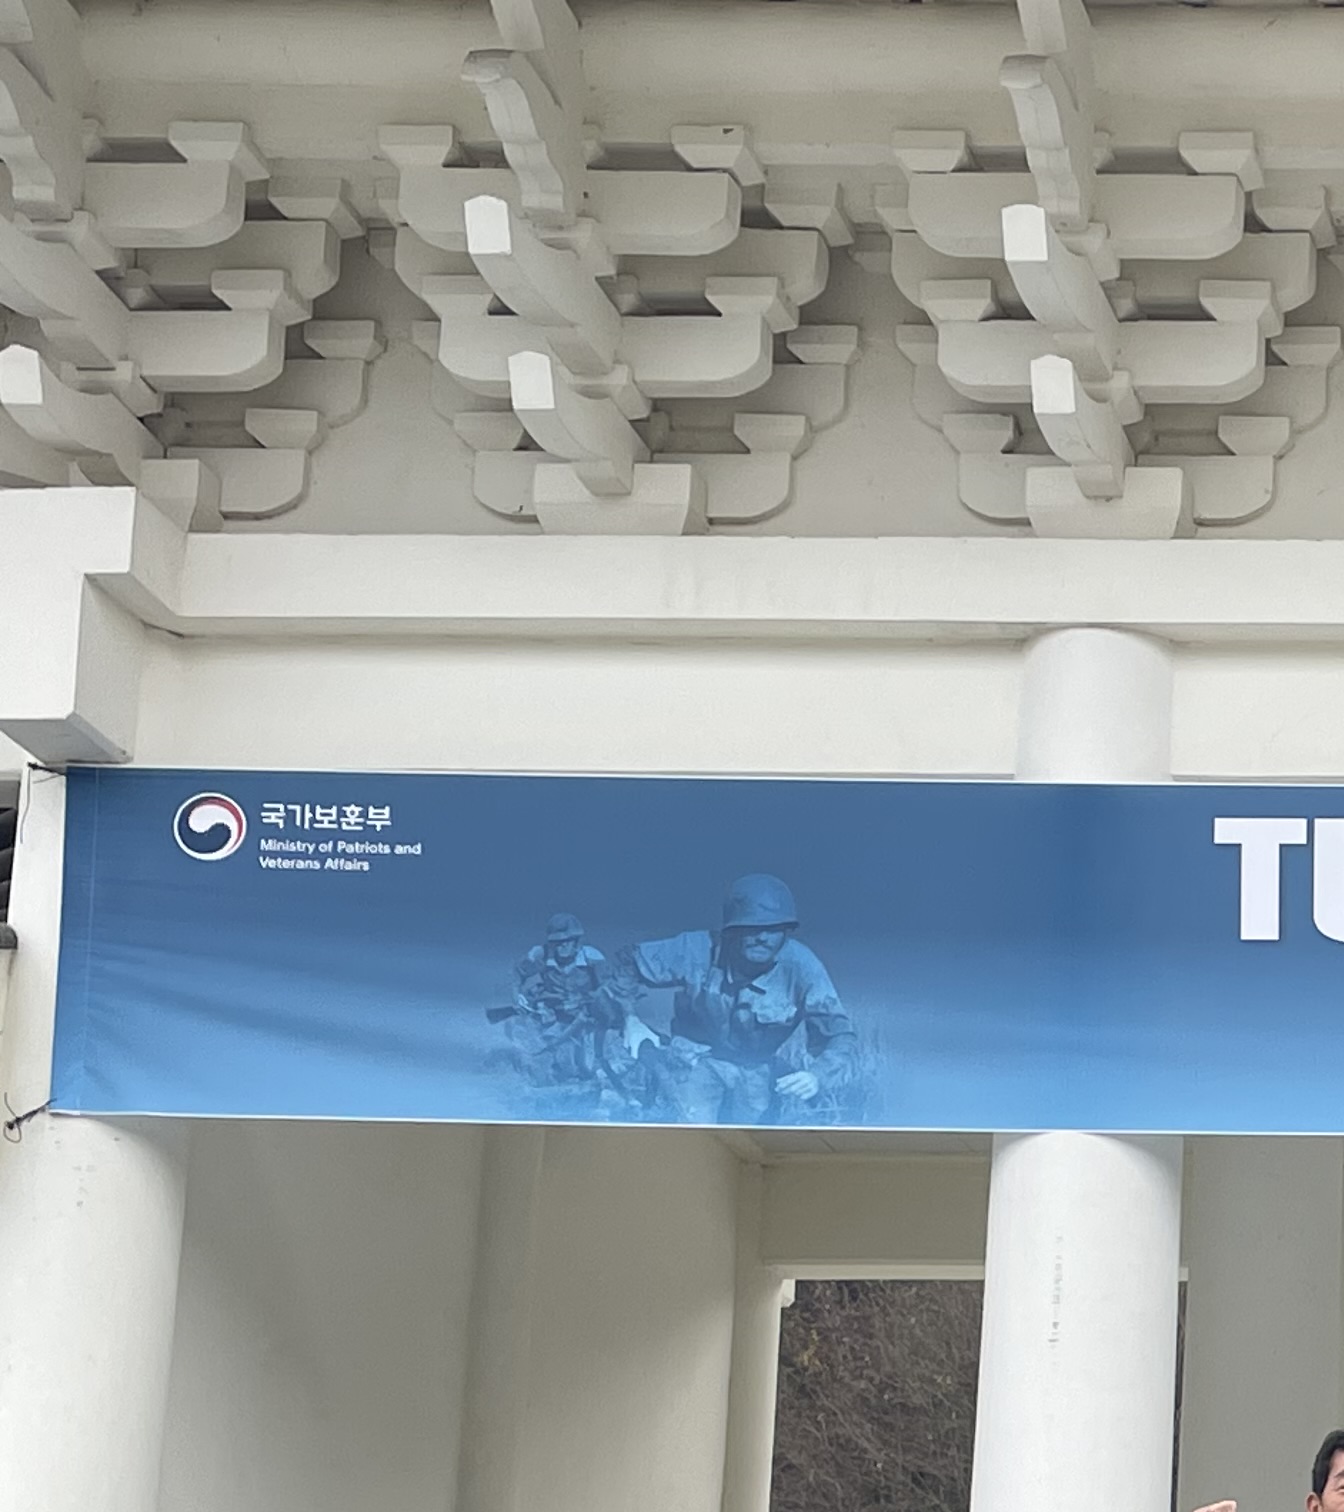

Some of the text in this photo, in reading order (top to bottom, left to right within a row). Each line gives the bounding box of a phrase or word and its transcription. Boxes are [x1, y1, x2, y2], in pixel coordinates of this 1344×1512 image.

[260, 802, 392, 832] 국가보훈부
[260, 838, 422, 855] Ministry of Patriots and
[259, 856, 370, 871] Veterans Affairs
